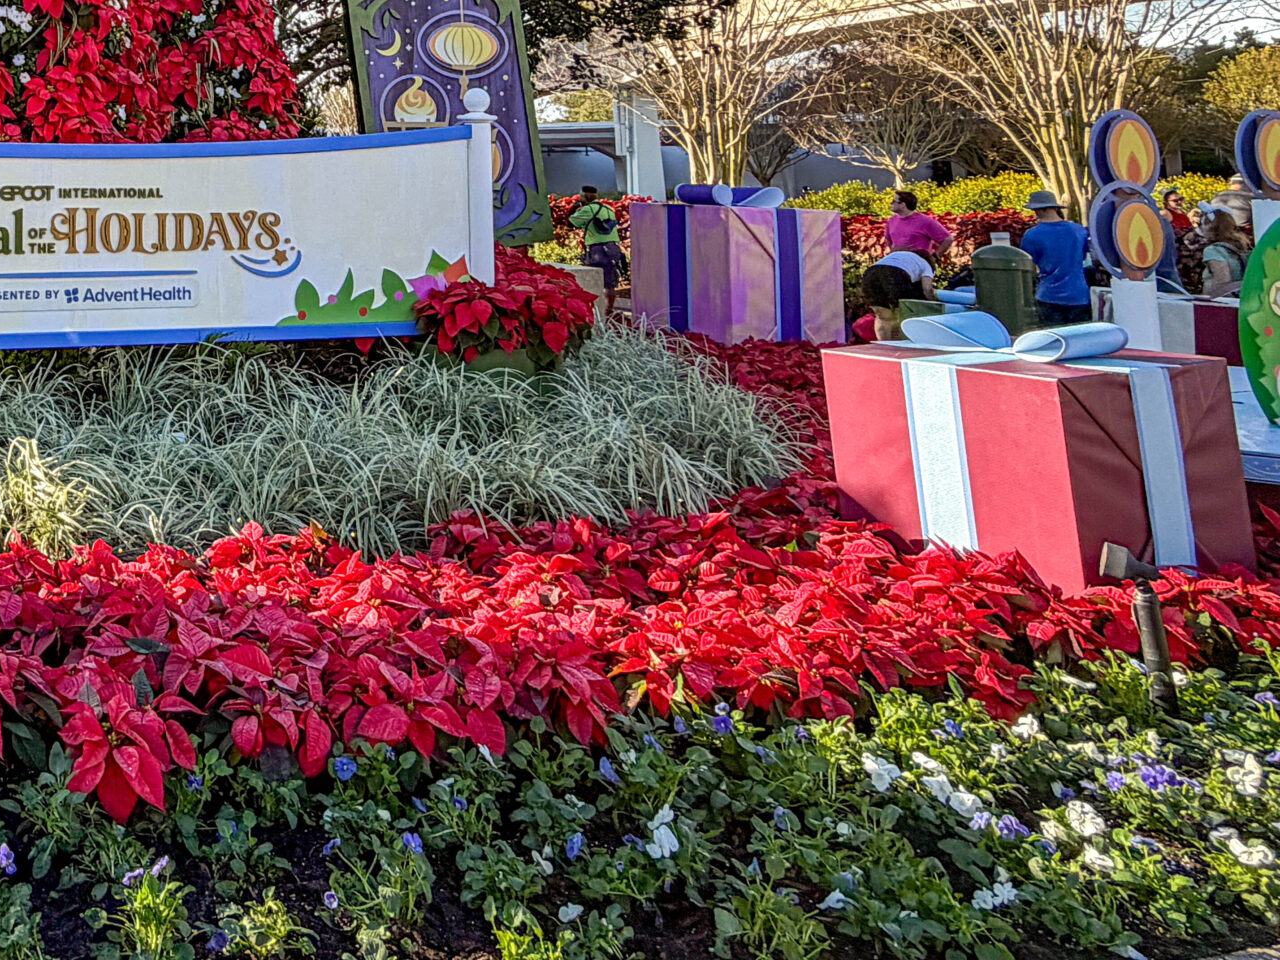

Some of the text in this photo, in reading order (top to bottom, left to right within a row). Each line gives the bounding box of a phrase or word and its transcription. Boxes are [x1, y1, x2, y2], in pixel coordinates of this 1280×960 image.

[57, 187, 164, 200] INTERNATIONAL
[27, 227, 47, 240] OF
[50, 207, 282, 255] HOLIDAYS
[27, 242, 56, 254] THE
[44, 289, 61, 300] BY
[82, 286, 192, 303] AdventHealth
